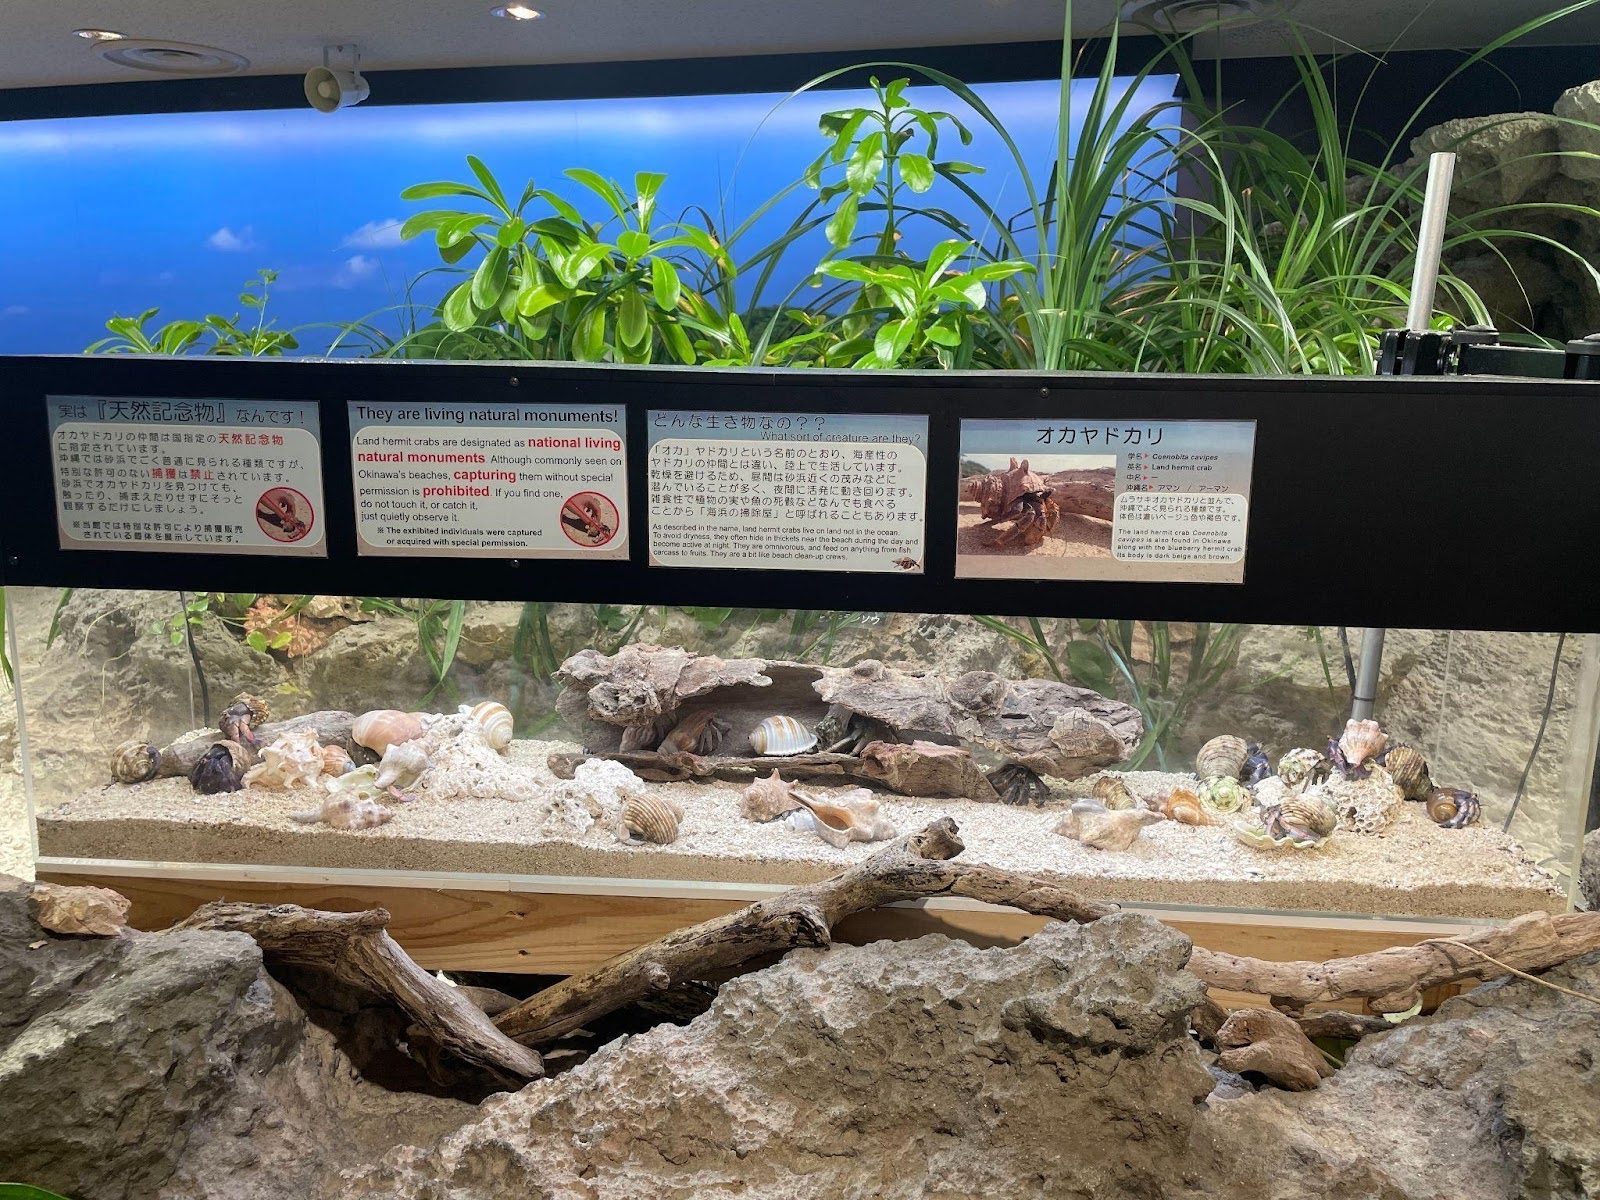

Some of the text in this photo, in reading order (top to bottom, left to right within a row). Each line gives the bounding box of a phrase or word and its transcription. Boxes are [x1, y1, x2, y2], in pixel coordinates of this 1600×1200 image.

[357, 406, 618, 424] They are living natural monuments!
[654, 413, 826, 430] どんな生き物なの？？
[356, 436, 380, 445] Land
[382, 437, 412, 446] hermit
[414, 438, 440, 446] crabs
[460, 438, 511, 449] designated
[528, 437, 581, 448] national
[585, 437, 621, 451] living
[760, 431, 921, 446] What sort of creature are they?
[1037, 427, 1162, 445] オカヤドカリ
[358, 452, 403, 462] natural
[490, 455, 532, 466] Although
[534, 456, 582, 467] commonly
[358, 469, 613, 483] Okinawa's beaches, capturing them without special
[359, 487, 410, 496] permission
[412, 487, 420, 496] is
[495, 488, 502, 497] If
[504, 490, 521, 499] you
[523, 489, 540, 498] find
[360, 499, 373, 508] do
[391, 500, 417, 509] touch
[419, 501, 428, 510] it,
[442, 501, 468, 510] catch
[469, 501, 478, 511] it,
[361, 511, 460, 523] just quietly observe it.
[396, 538, 431, 546] acquired
[451, 539, 480, 547] special
